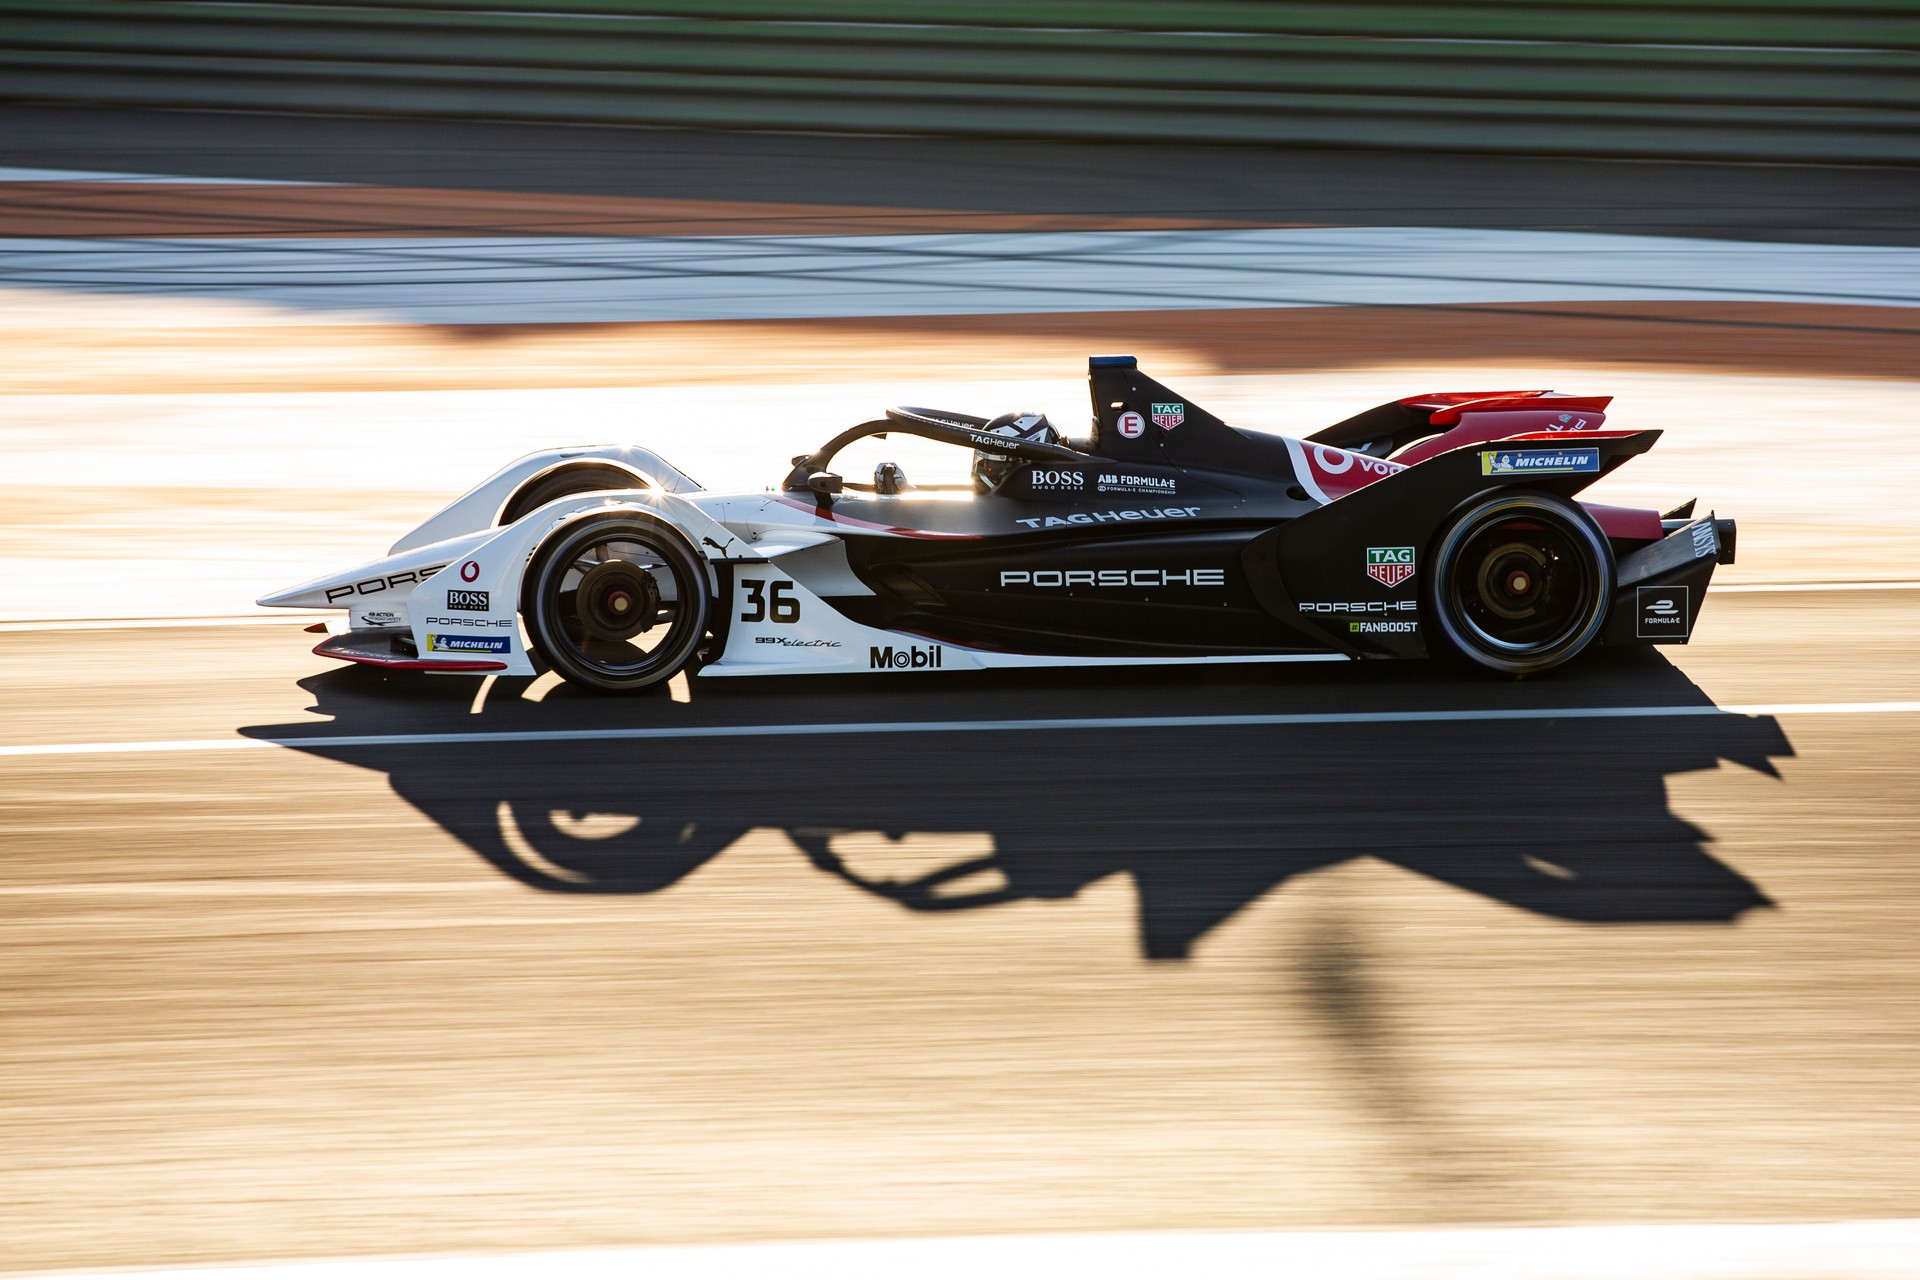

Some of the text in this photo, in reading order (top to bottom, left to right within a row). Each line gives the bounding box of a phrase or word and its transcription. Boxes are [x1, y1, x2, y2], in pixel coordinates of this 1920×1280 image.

[1154, 405, 1181, 414] TAG
[1124, 416, 1139, 434] E
[1154, 415, 1182, 428] HEUER
[970, 433, 1020, 450] TAGHeuer
[1515, 455, 1589, 467] MICHELIN
[1031, 470, 1084, 485] BOSS
[1097, 474, 1118, 484] ABB
[1015, 506, 1201, 529] TAGHeuer
[1370, 549, 1411, 562] TAG
[1000, 569, 1225, 587] PORSCHE
[1369, 564, 1413, 585] HEUER
[449, 591, 488, 606] BOSS
[740, 578, 801, 624] 36
[1299, 600, 1417, 612] PORSCHE
[426, 617, 513, 628] PORSCHE
[1349, 622, 1418, 633] #FANBOOST
[450, 640, 504, 649] MICHELIN
[870, 645, 942, 669] Mobil
